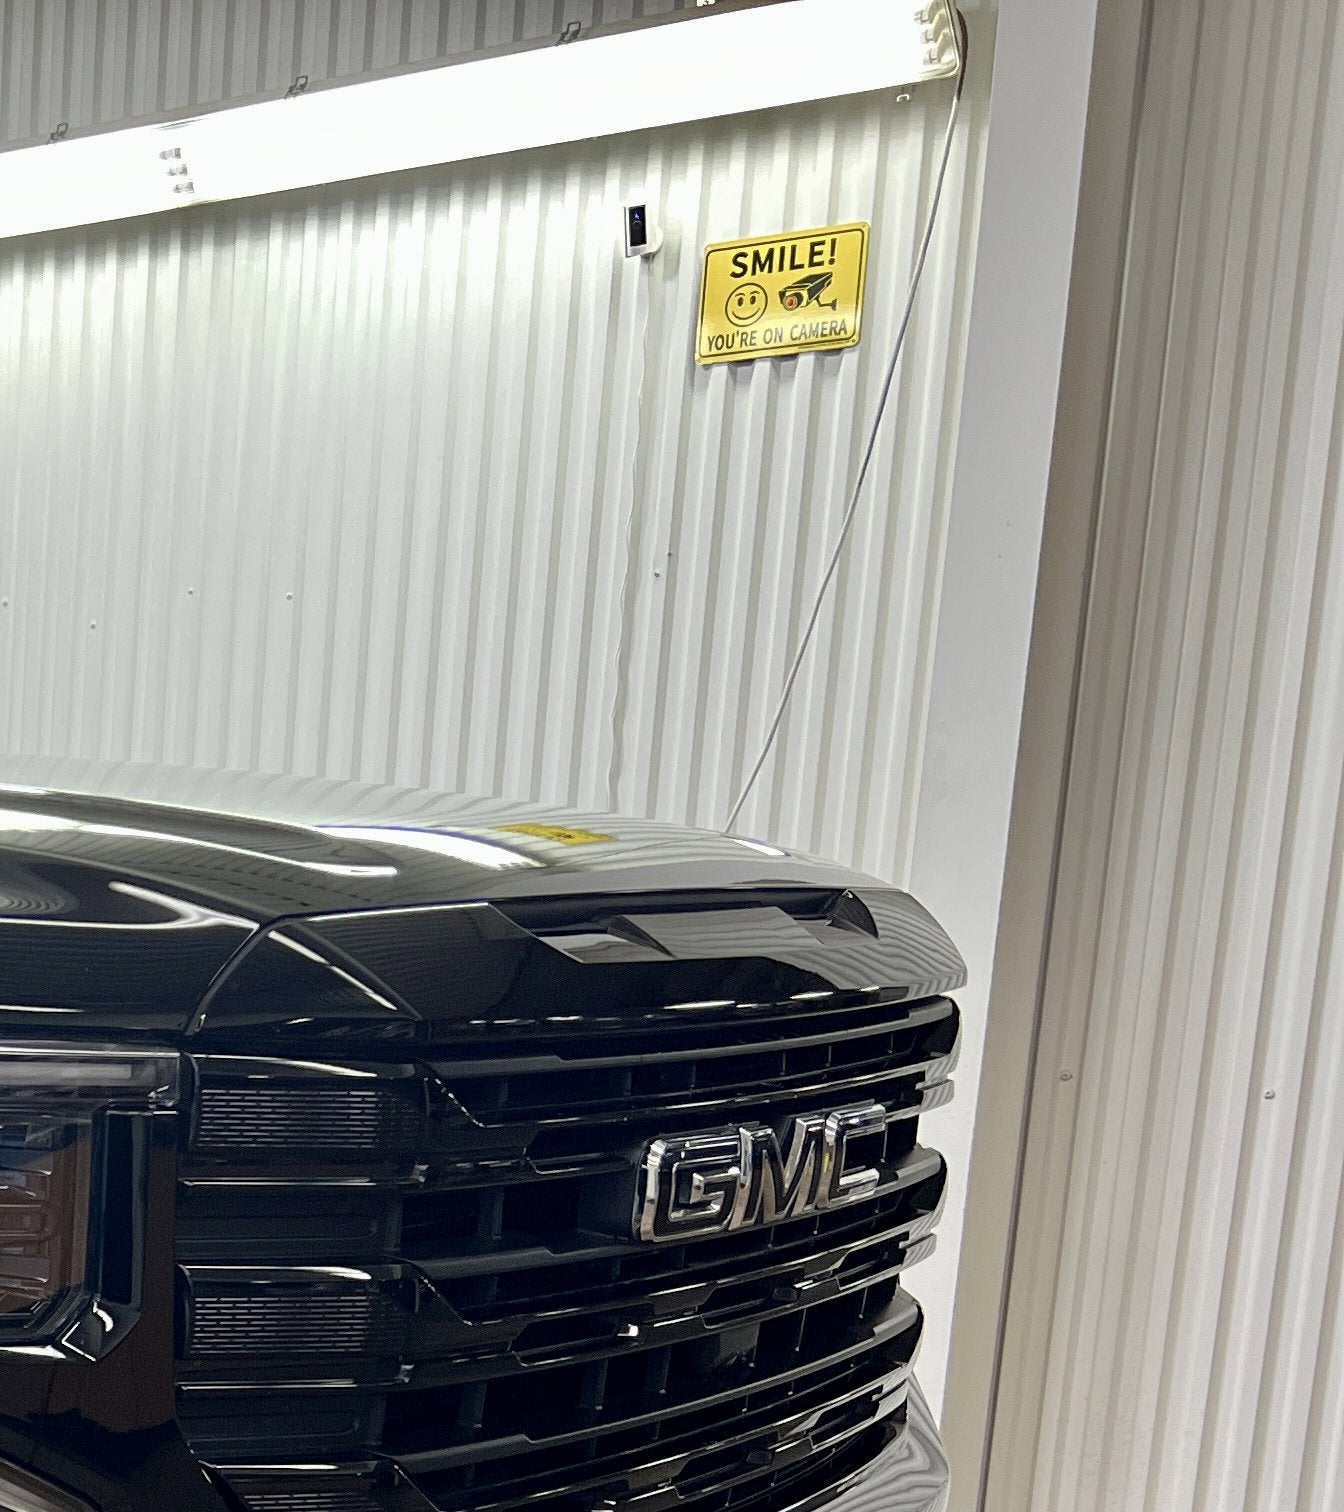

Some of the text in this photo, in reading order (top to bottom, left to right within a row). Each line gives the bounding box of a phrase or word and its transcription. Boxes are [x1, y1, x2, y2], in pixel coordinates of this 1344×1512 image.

[729, 238, 838, 279] SMILE!
[707, 318, 849, 352] YOU'RE ON CAMERA
[634, 1102, 887, 1242] GMC
